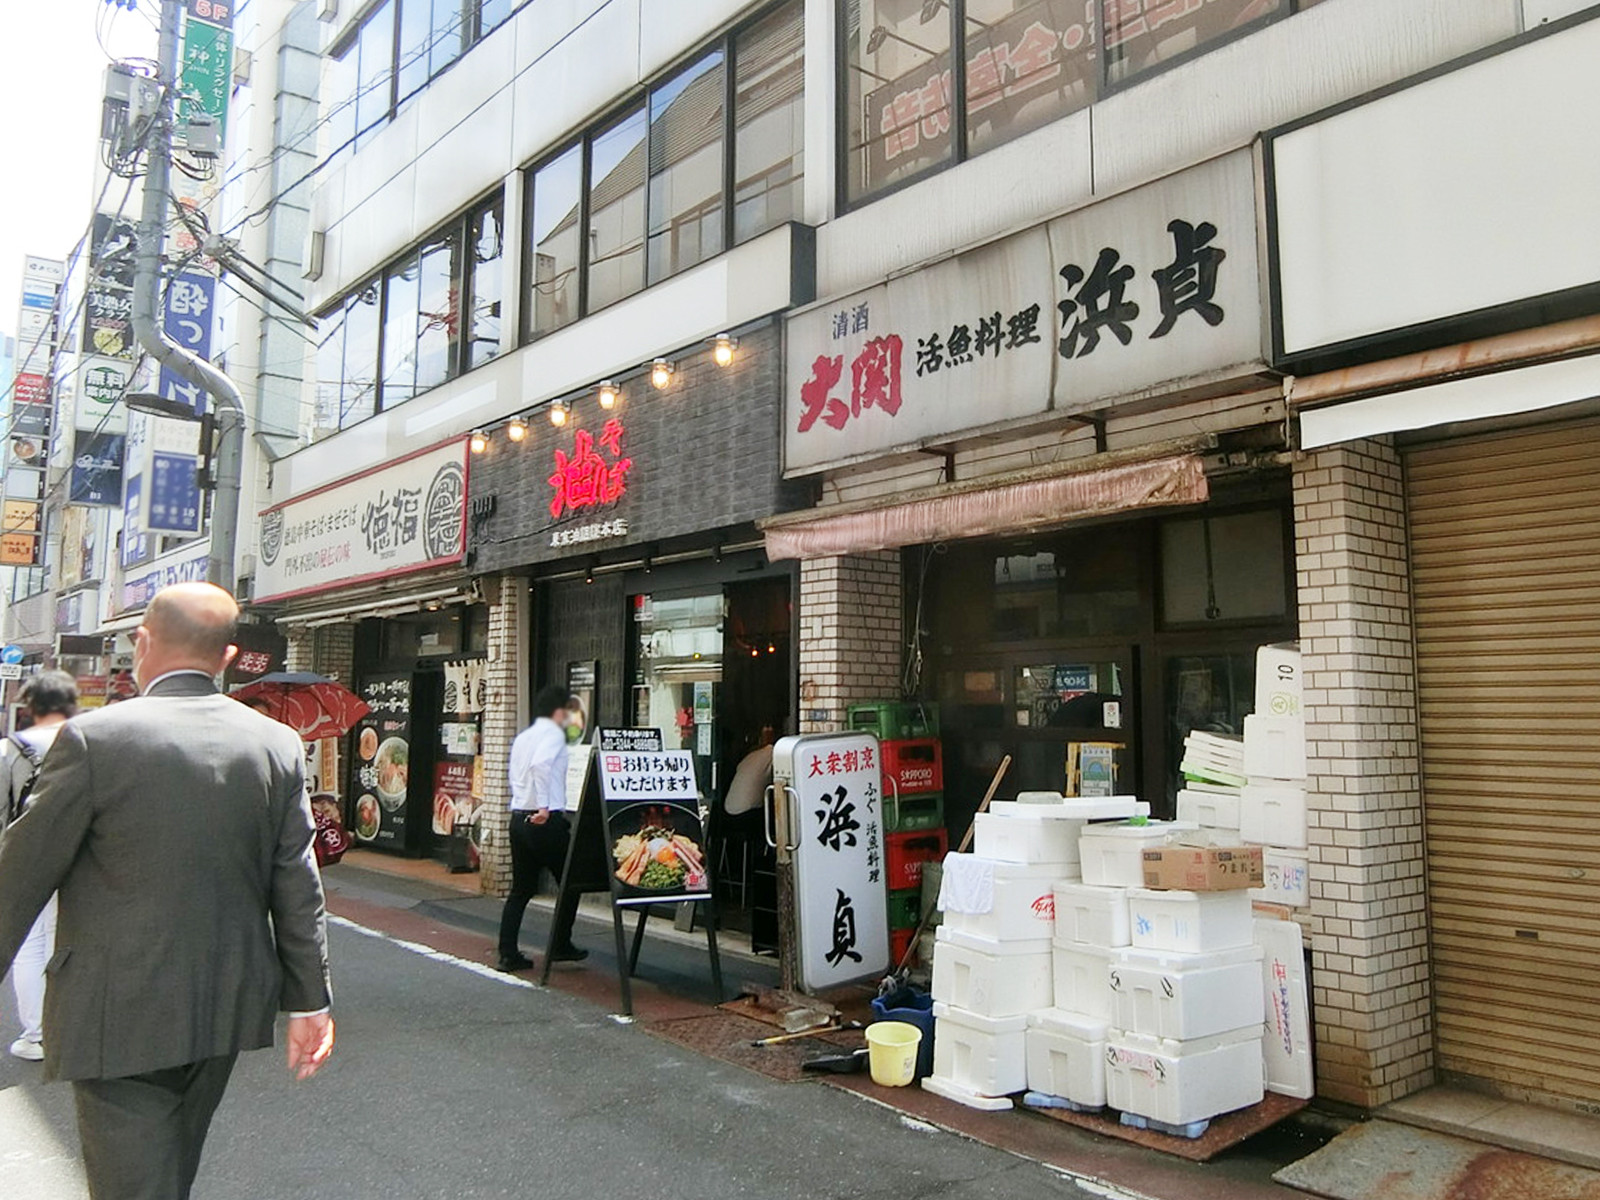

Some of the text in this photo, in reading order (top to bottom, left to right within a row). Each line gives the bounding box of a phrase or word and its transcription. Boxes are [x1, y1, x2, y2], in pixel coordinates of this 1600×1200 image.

[195, 0, 229, 20] 6F
[1057, 218, 1227, 359] 浜貞
[832, 301, 869, 340] 清酒
[916, 303, 1041, 377] 活魚料理
[86, 369, 125, 388] 無料
[797, 333, 904, 432] 大関
[1277, 664, 1294, 681] 10
[623, 756, 689, 772] お持ち帰り
[807, 746, 876, 779] 大衆割烹
[610, 776, 691, 792] いただけます
[866, 821, 880, 883] 活魚料理
[814, 784, 863, 968] 浜貞
